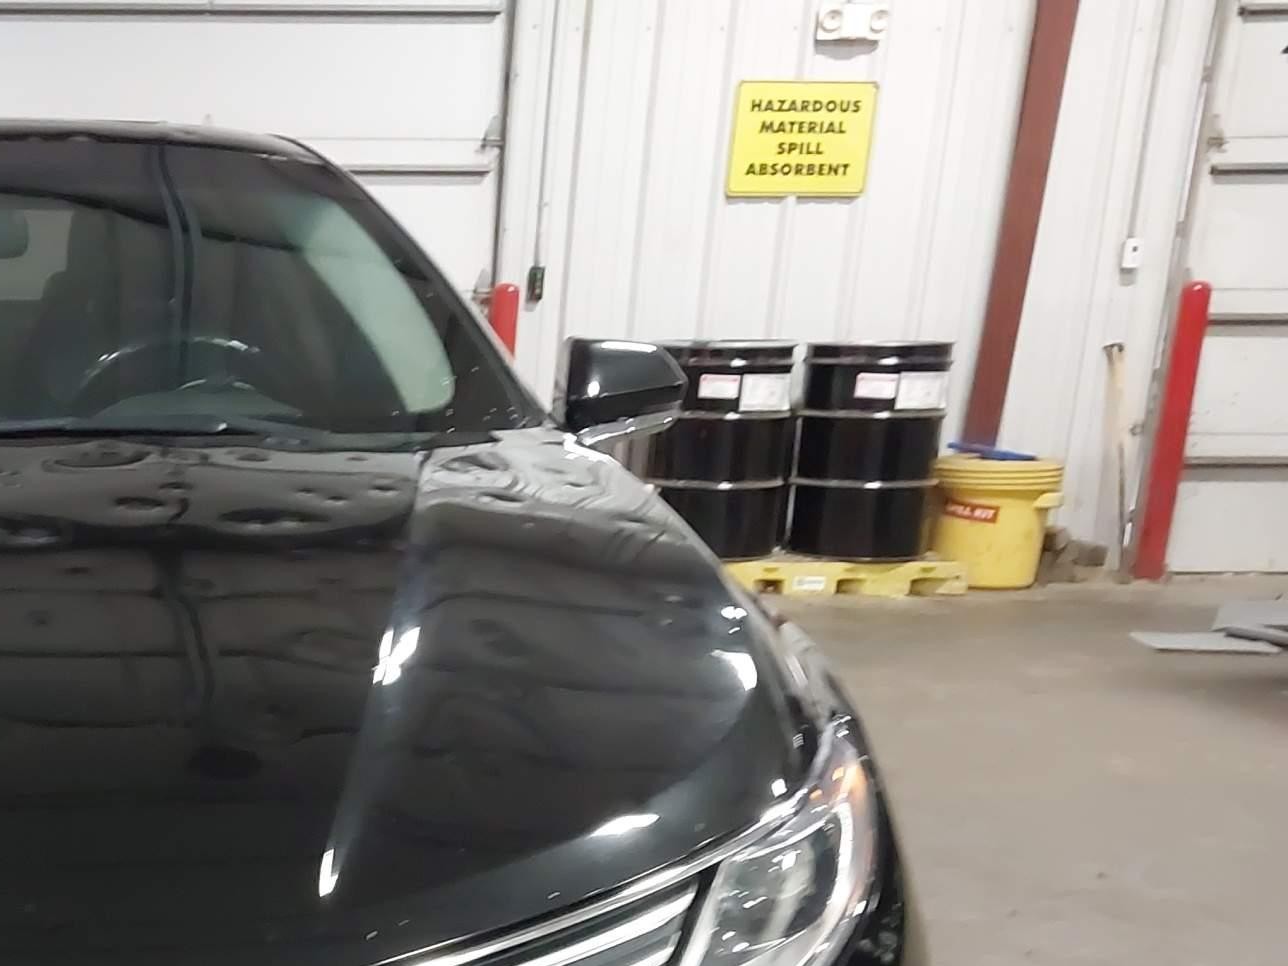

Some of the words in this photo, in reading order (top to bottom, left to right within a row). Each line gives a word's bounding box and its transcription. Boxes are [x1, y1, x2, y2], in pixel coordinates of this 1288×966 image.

[750, 99, 862, 113] HAZARDOUS
[758, 121, 847, 134] MATERIAL
[776, 142, 824, 155] SPILL
[744, 163, 851, 176] ABSORBENT
